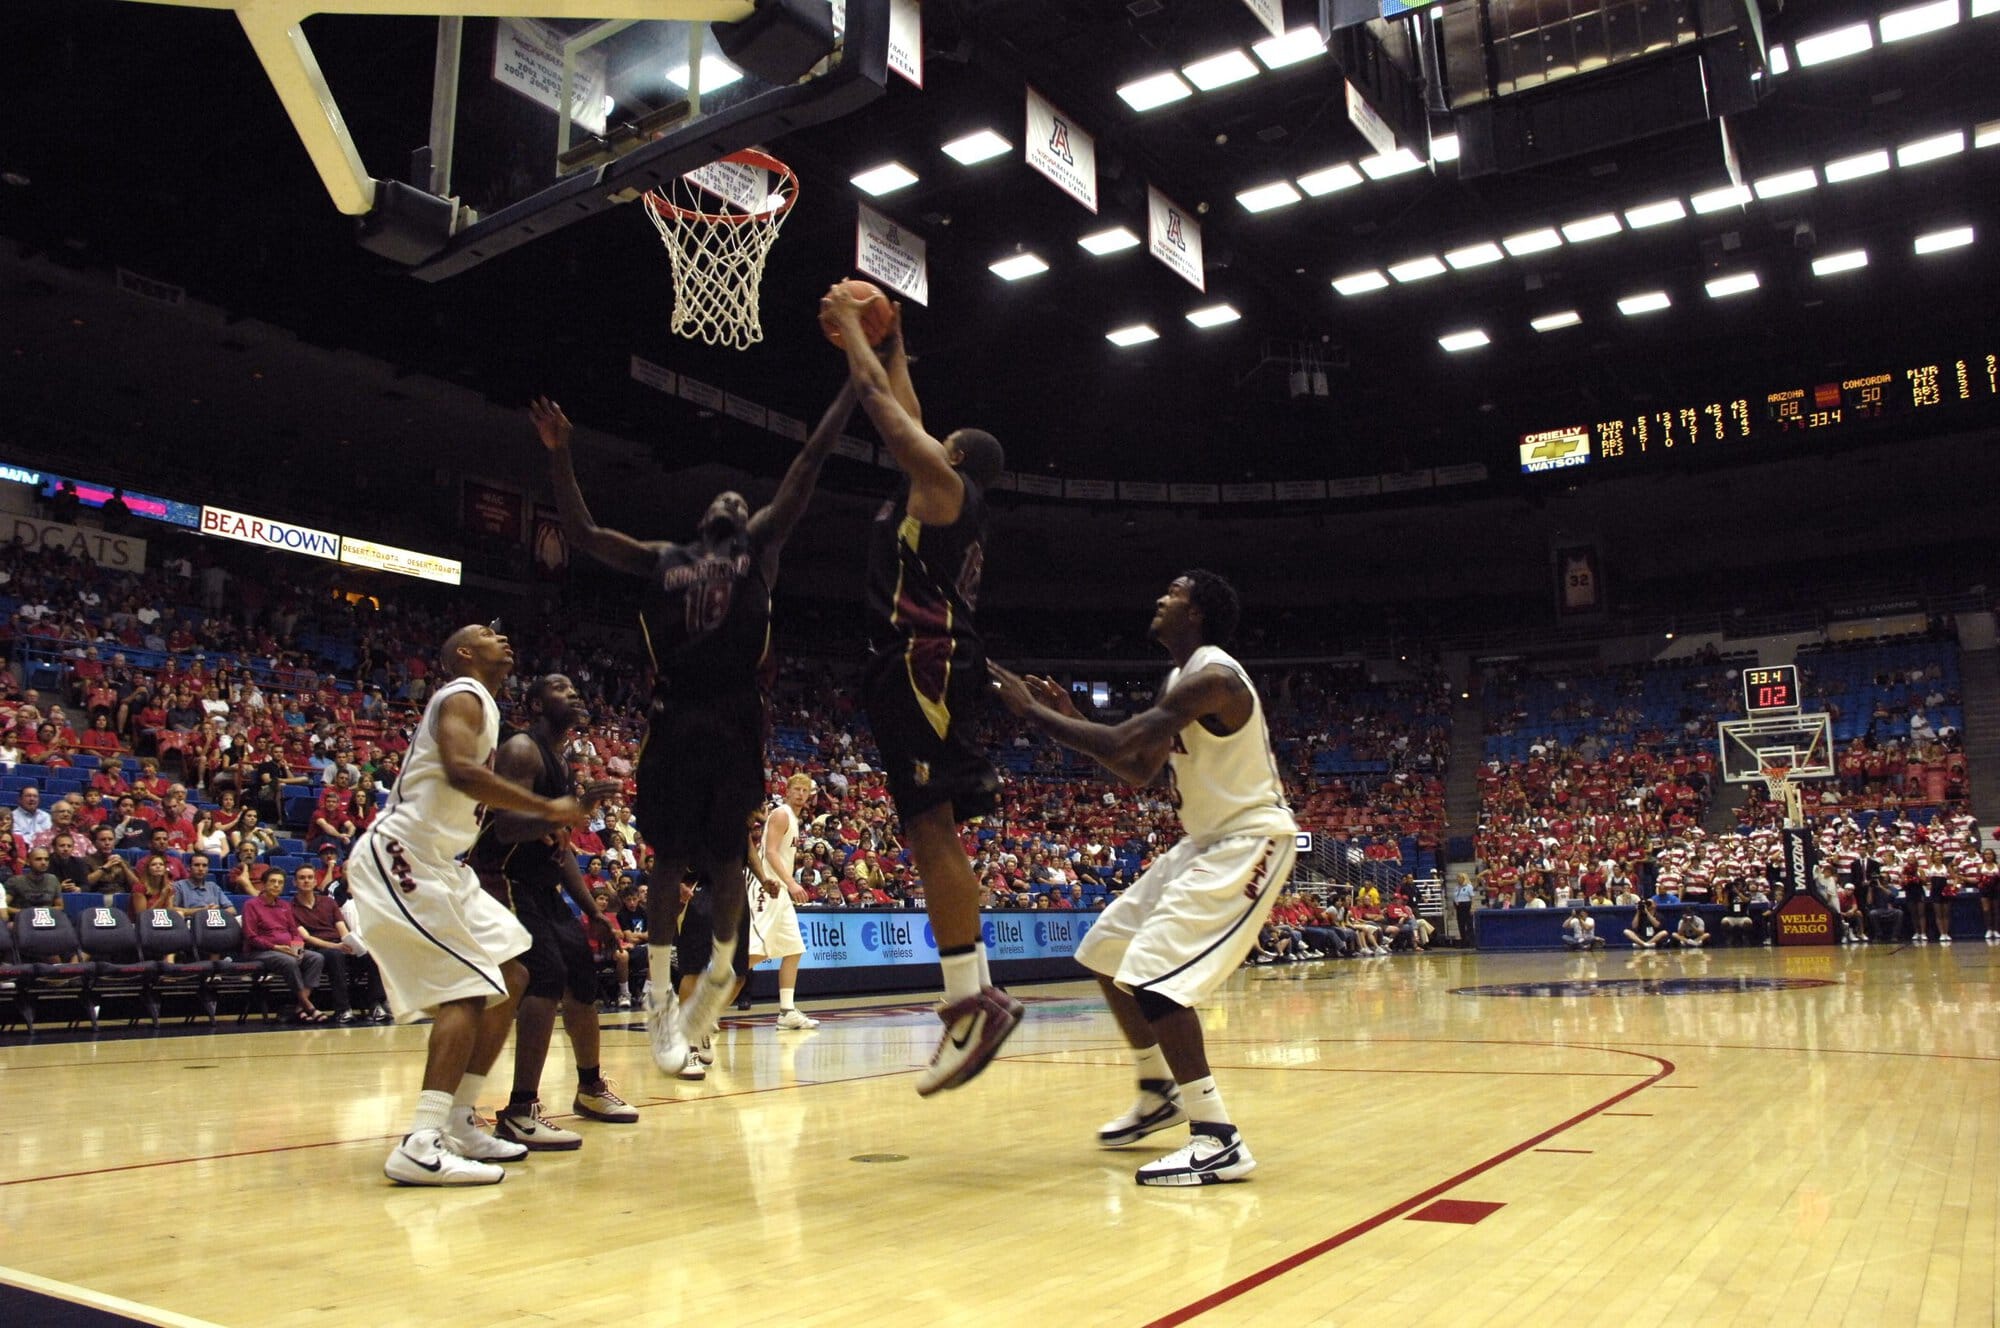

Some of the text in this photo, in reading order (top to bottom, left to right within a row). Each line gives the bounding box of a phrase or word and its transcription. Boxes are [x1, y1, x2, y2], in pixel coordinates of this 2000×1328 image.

[1906, 364, 1939, 380] PLYR
[1913, 374, 1936, 388] PTS
[1842, 373, 1892, 391] CONCORDIA
[1912, 384, 1939, 397] RBS
[1767, 388, 1804, 403] ARIZONA
[1861, 387, 1880, 403] 50
[1913, 394, 1940, 407] FLS
[1596, 420, 1624, 433] PLYR
[1637, 416, 1647, 425] 5
[1704, 403, 1722, 414] 42
[1730, 399, 1748, 410] 43
[1779, 401, 1799, 416] 68
[1808, 409, 1841, 428] 33.4
[1524, 426, 1582, 444] O'RIELLY
[1601, 437, 1624, 449] RBS
[1602, 429, 1622, 440] PTS
[1602, 446, 1624, 458] FLS
[1664, 438, 1674, 448] 0
[1715, 431, 1725, 440] 0
[1527, 455, 1586, 472] WATSON
[0, 519, 131, 567] DCATS
[342, 544, 460, 575] DESERT TOYOTA DESERT TOYOTA
[1569, 573, 1589, 587] 32
[1750, 670, 1781, 685] 33.4
[1759, 685, 1786, 707] 02
[385, 840, 417, 895] CATS
[1790, 833, 1807, 891] ARIZONA
[757, 886, 765, 912] CATS
[32, 907, 55, 927] A
[94, 907, 116, 927] A
[152, 908, 173, 927] A
[206, 909, 226, 927] A
[1780, 913, 1828, 924] WELLS
[866, 921, 912, 948] alltel
[986, 920, 1024, 945] alltel
[1038, 920, 1072, 944] alltel
[1783, 924, 1828, 935] FARGO
[812, 949, 847, 961] wireless
[882, 948, 913, 959] wireless
[999, 944, 1025, 955] wireless
